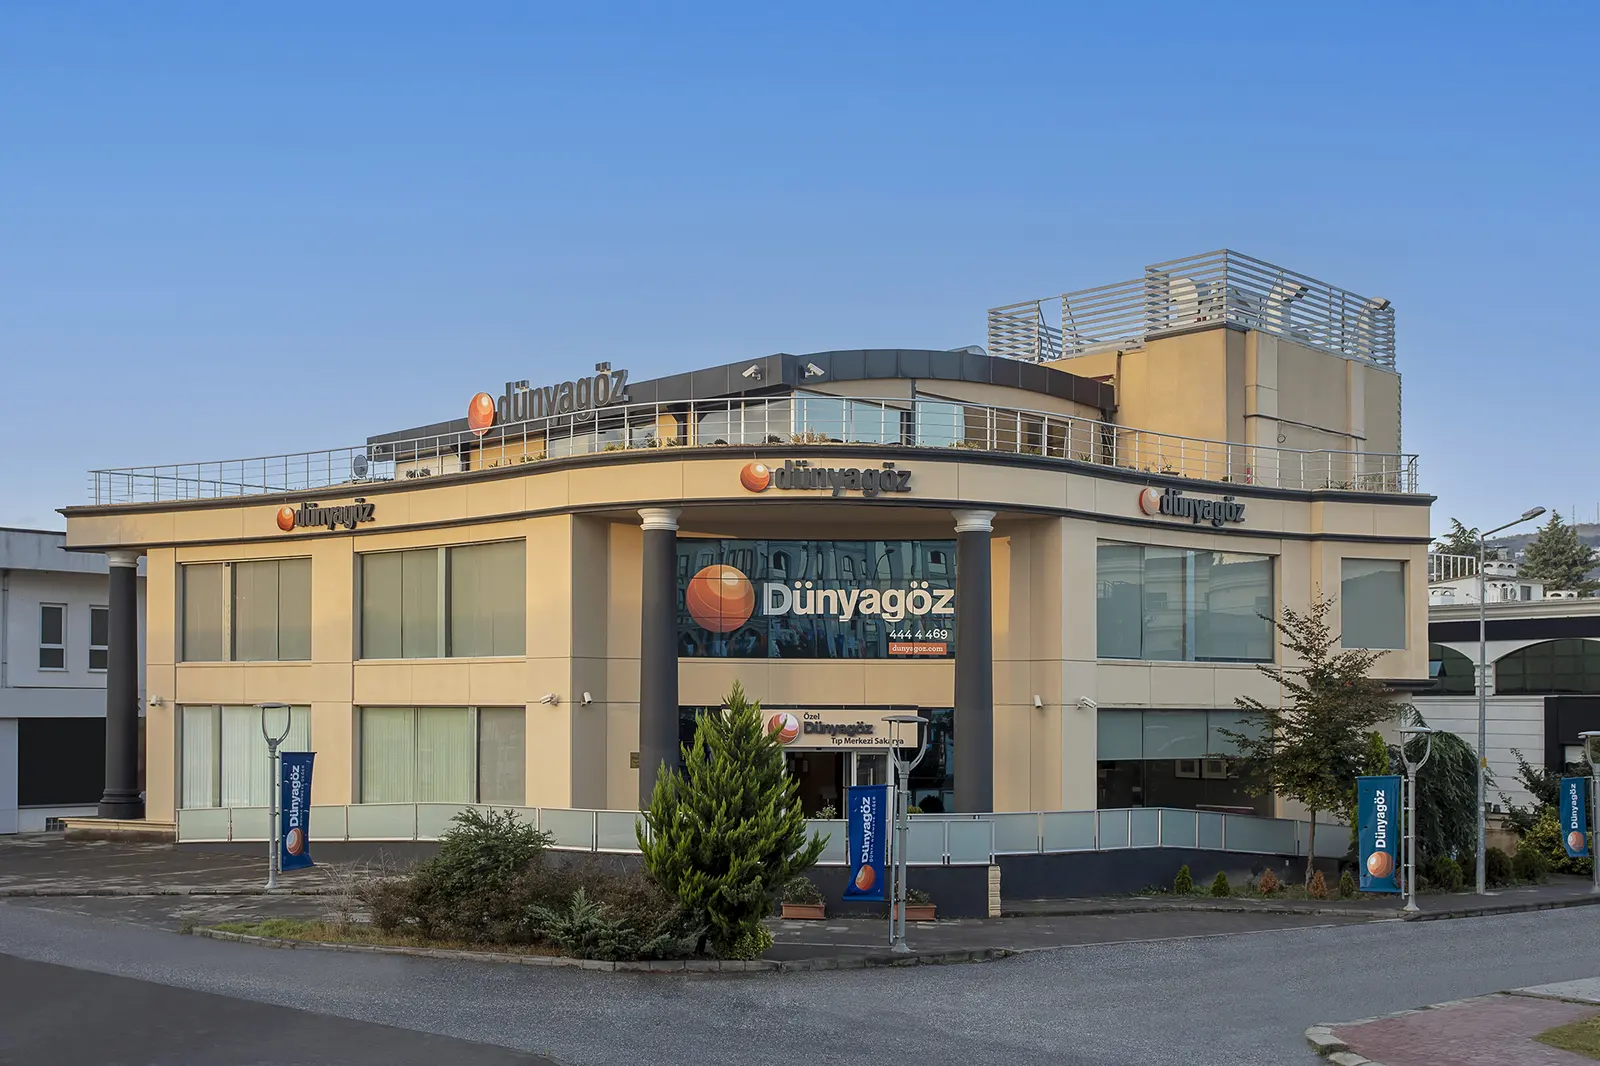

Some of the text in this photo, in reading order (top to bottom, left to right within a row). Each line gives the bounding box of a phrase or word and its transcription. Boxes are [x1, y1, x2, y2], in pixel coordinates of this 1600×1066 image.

[497, 361, 629, 426] dünyagöz
[774, 459, 912, 497] dünyagöz
[295, 497, 376, 530] dünyagöz
[1160, 487, 1246, 527] dünyagöz
[763, 580, 955, 622] Dünyagöz
[889, 628, 948, 640] 444 4 469
[892, 644, 944, 653] dunyagoz.com
[803, 711, 820, 720] Özel
[803, 721, 874, 737] Dünyagöz
[843, 737, 874, 745] Merkezi
[289, 764, 301, 828] Dünyagöz
[1569, 783, 1579, 829] Dünyagöz
[860, 796, 873, 863] Dünyagöz
[1374, 789, 1388, 848] Dünyagöz
